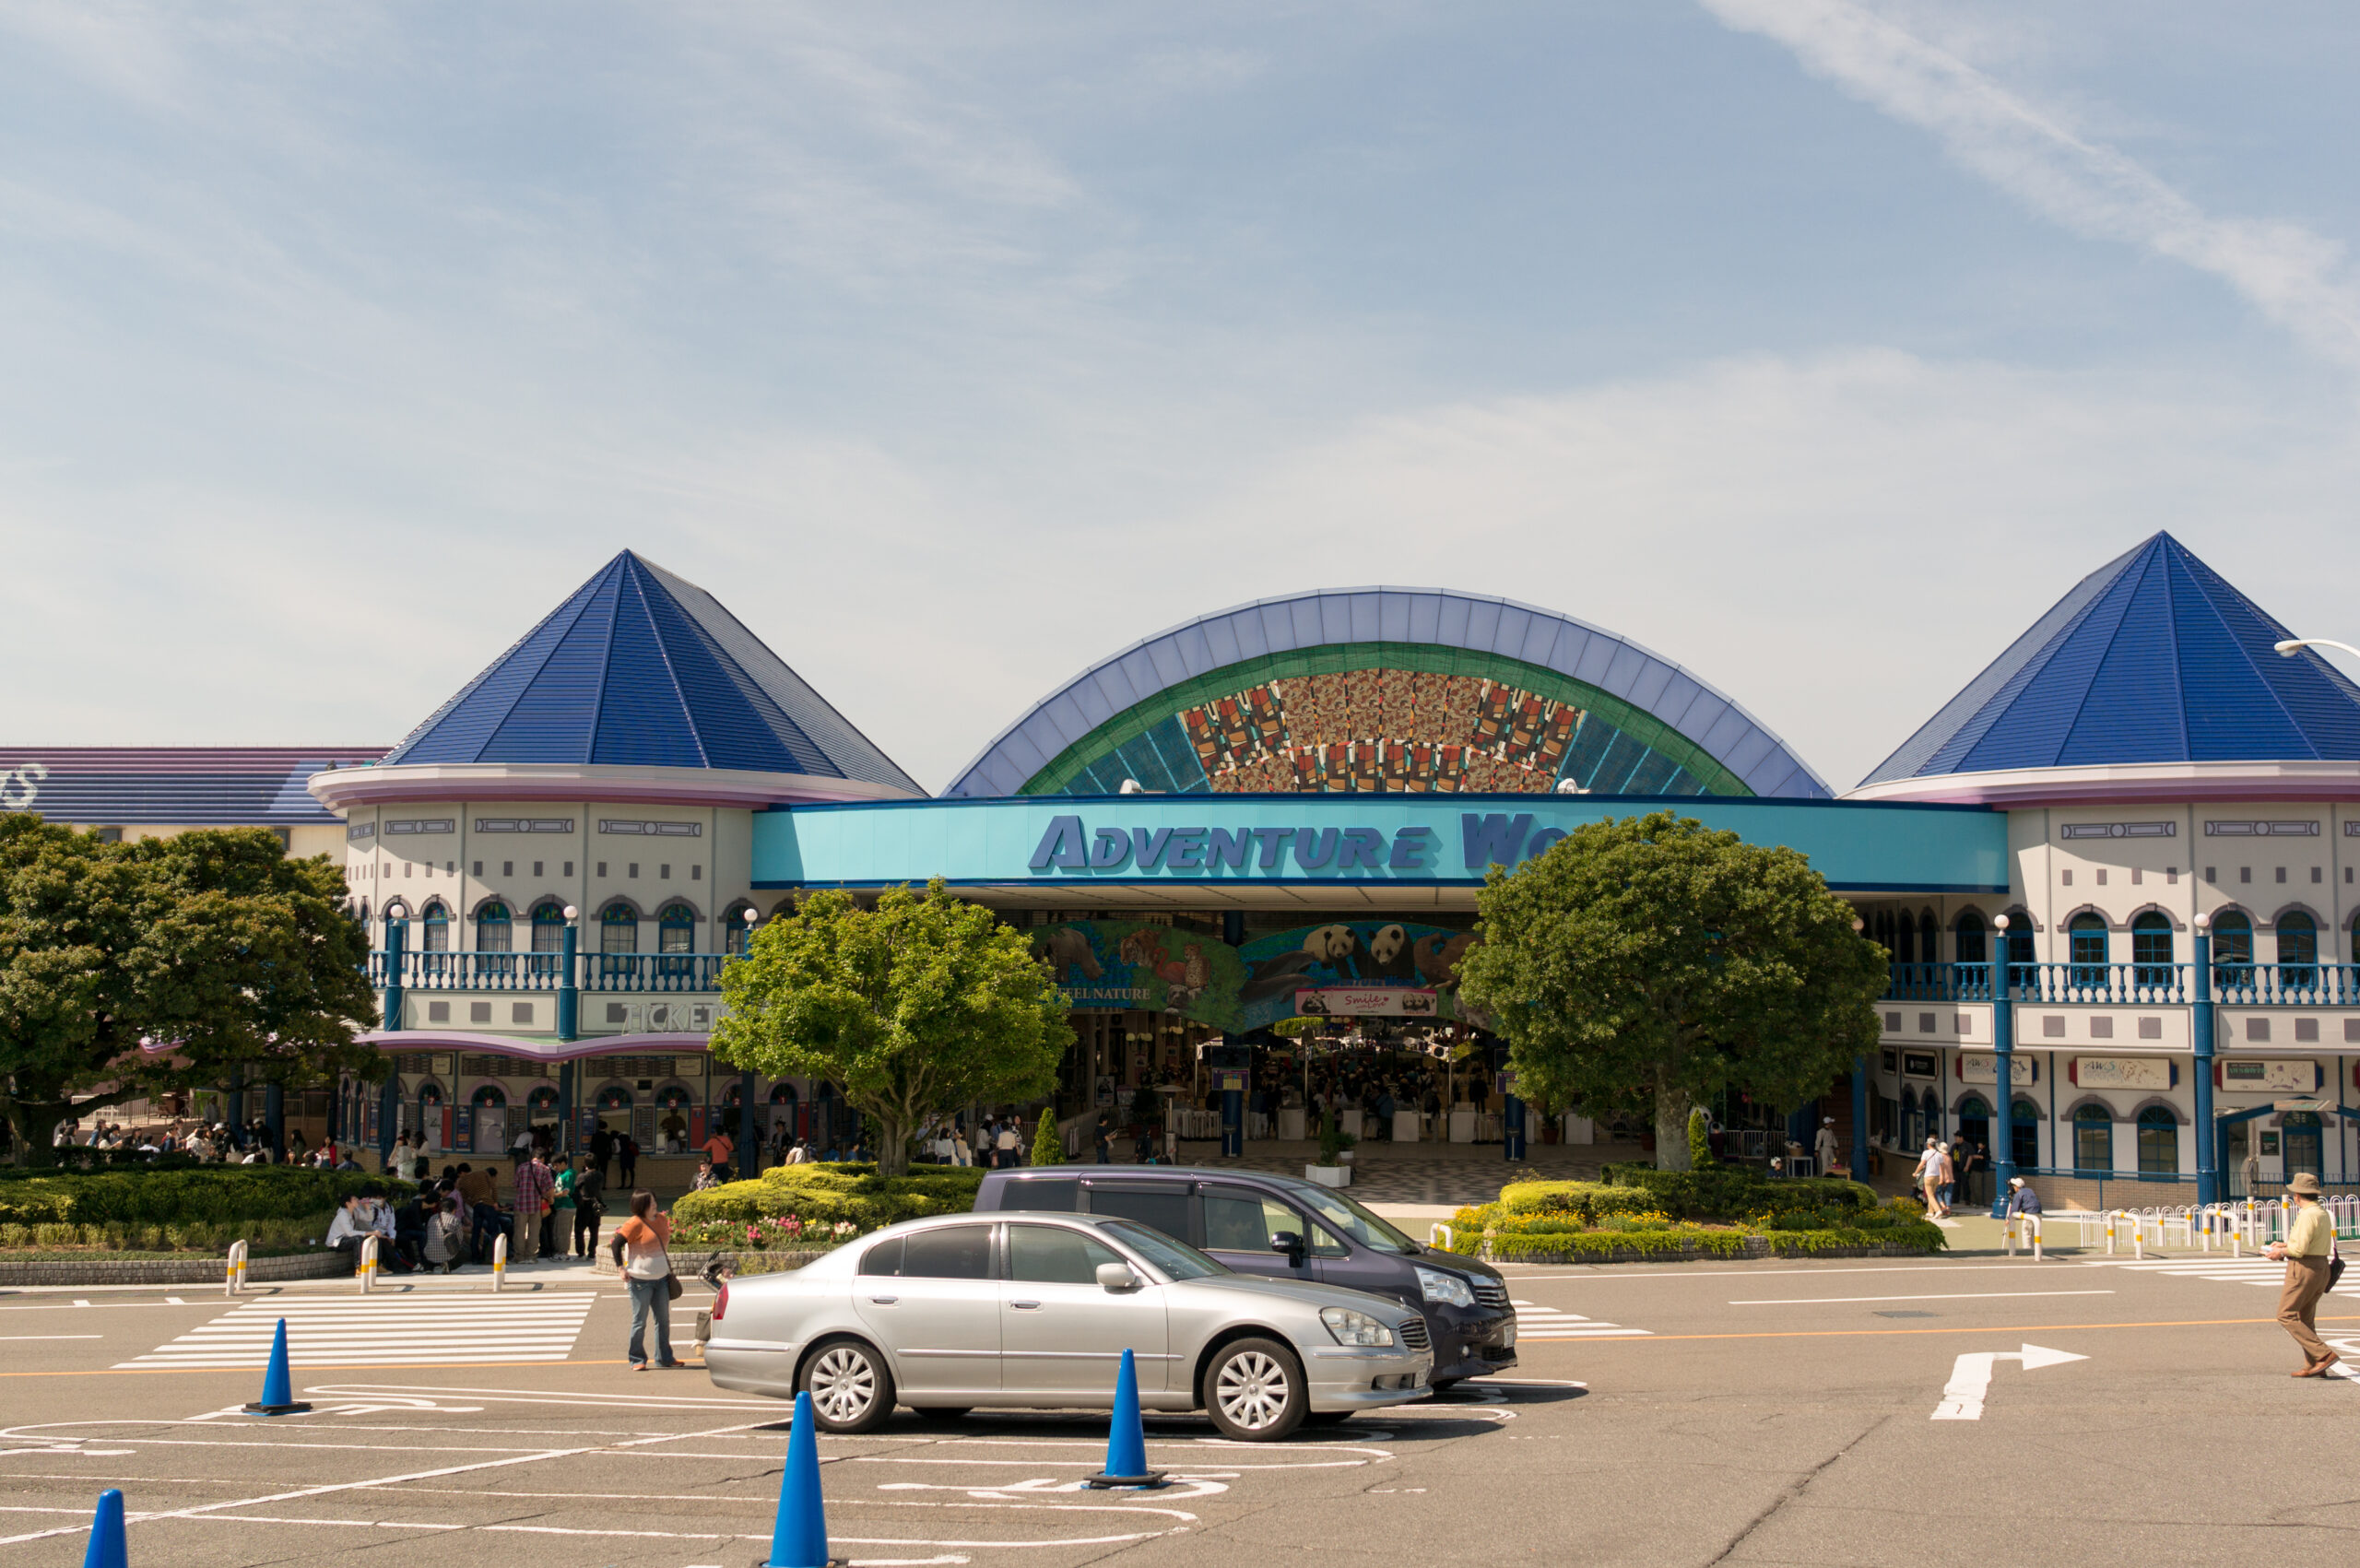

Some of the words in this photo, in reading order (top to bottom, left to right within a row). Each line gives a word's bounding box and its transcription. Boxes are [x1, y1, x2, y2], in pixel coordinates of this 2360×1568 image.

[1028, 815, 1432, 868] ADVENTURE
[1092, 987, 1151, 1001] NATURE
[1344, 993, 1382, 1006] Smile
[429, 1097, 435, 1105] 7
